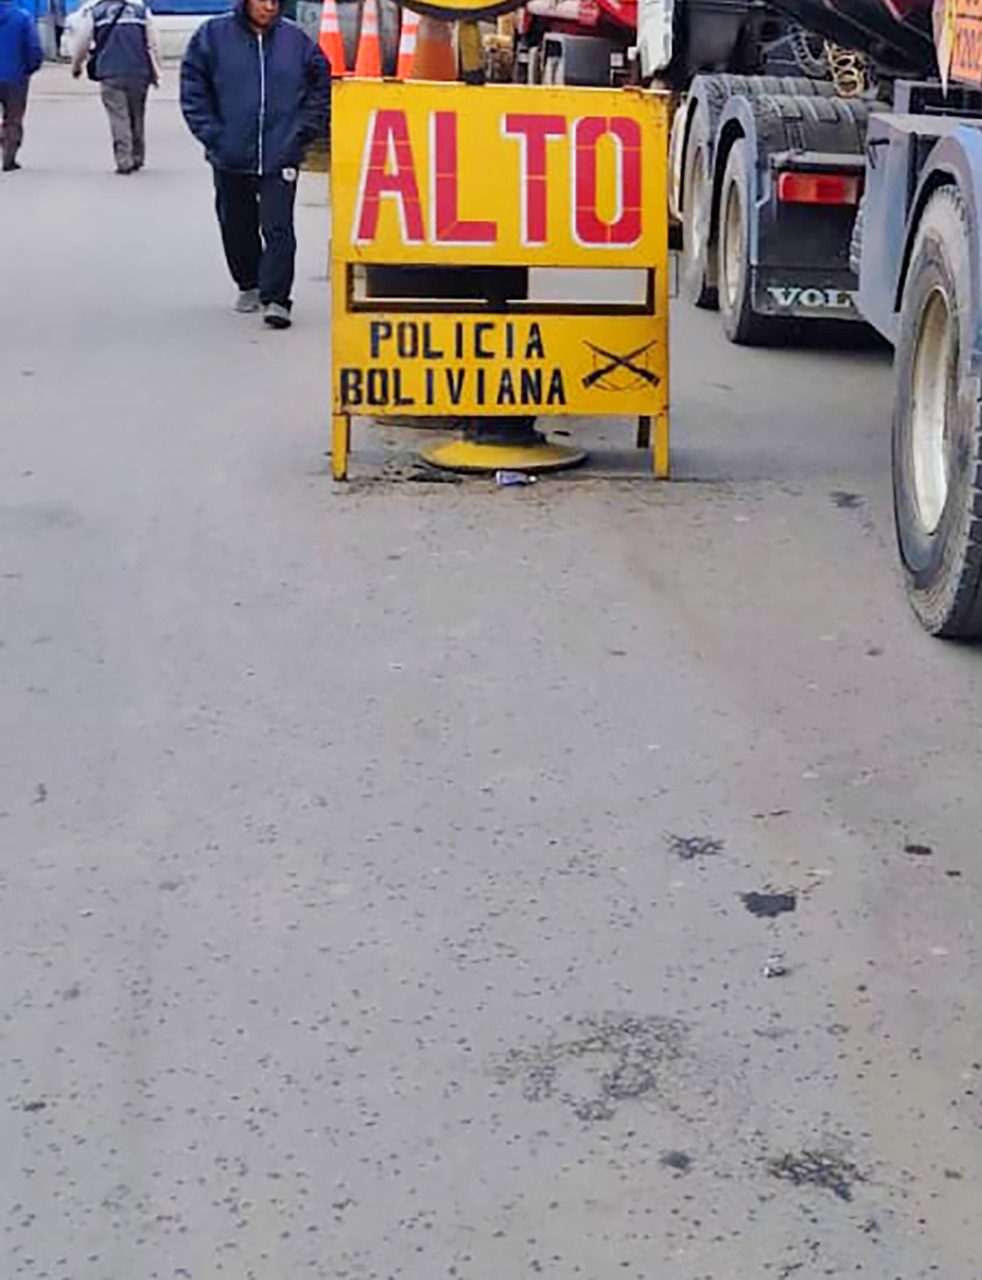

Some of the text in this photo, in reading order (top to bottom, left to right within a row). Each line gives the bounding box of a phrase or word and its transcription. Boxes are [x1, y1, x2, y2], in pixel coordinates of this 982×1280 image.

[351, 109, 643, 249] ALTO
[767, 287, 859, 308] VOL
[369, 321, 545, 360] POLICIA
[340, 368, 567, 407] BOLIVIANA
